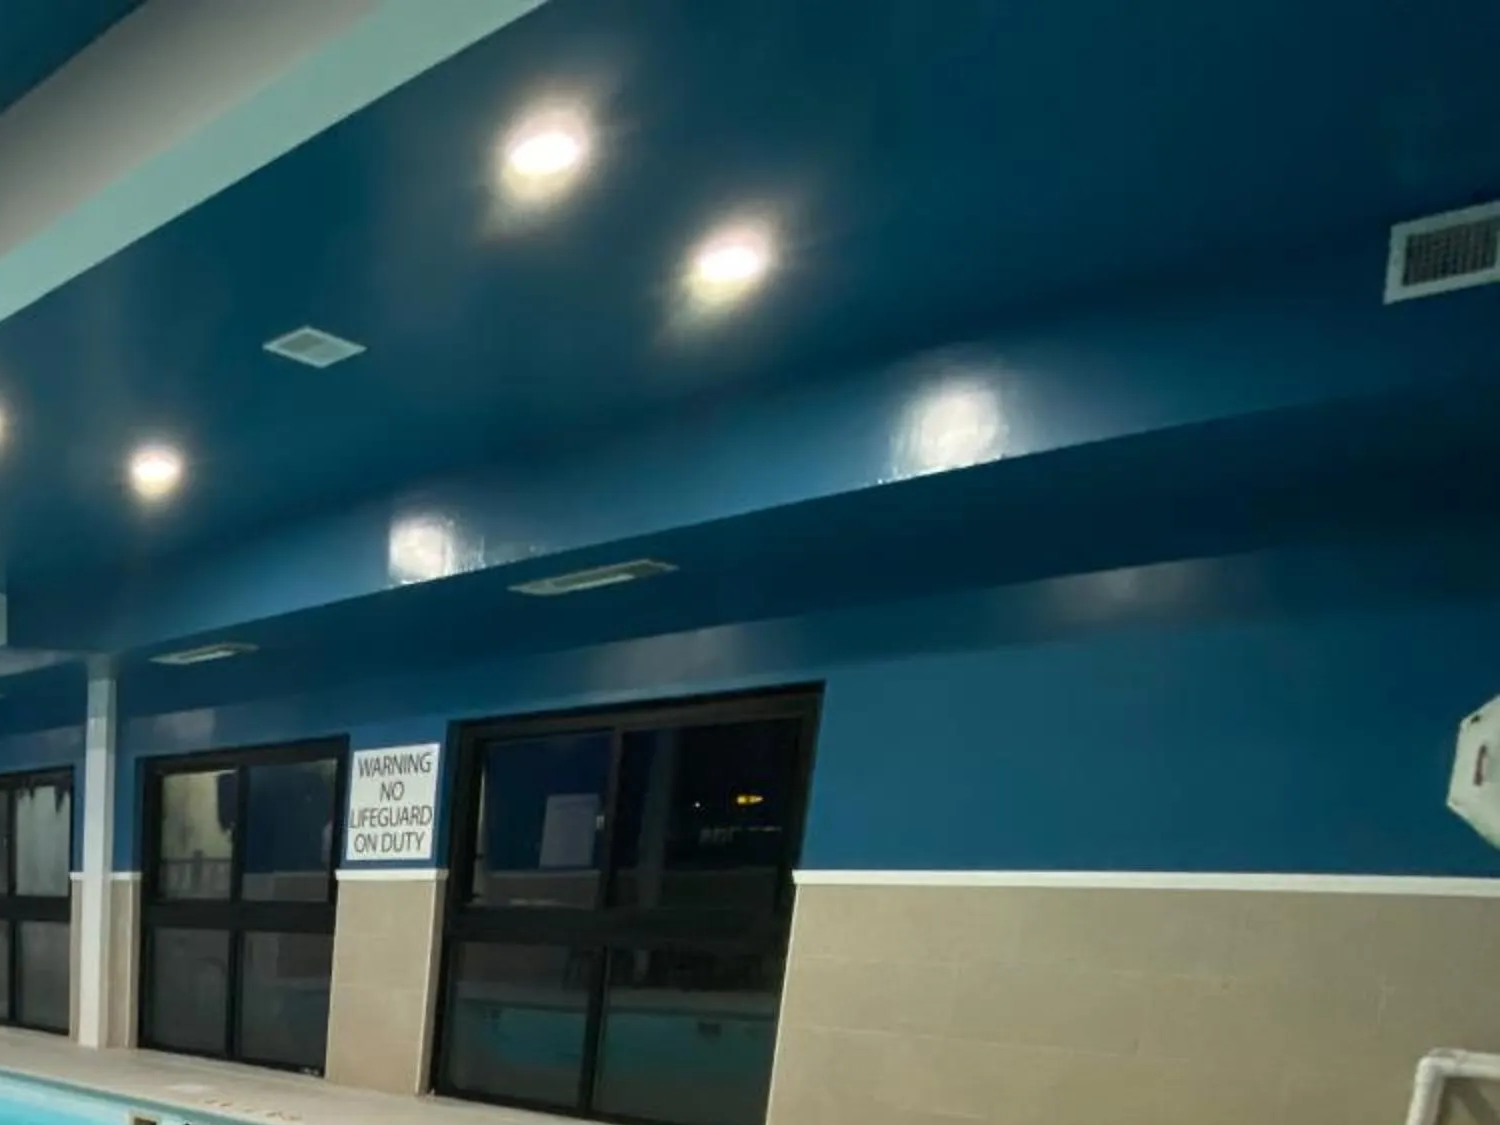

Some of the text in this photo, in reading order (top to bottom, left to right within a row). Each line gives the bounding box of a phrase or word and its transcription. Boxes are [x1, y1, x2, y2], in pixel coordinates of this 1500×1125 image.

[358, 752, 432, 777] WARNING
[379, 781, 405, 802] NO
[350, 804, 433, 828] LIFEGUARD
[353, 831, 426, 853] ON DUTY
